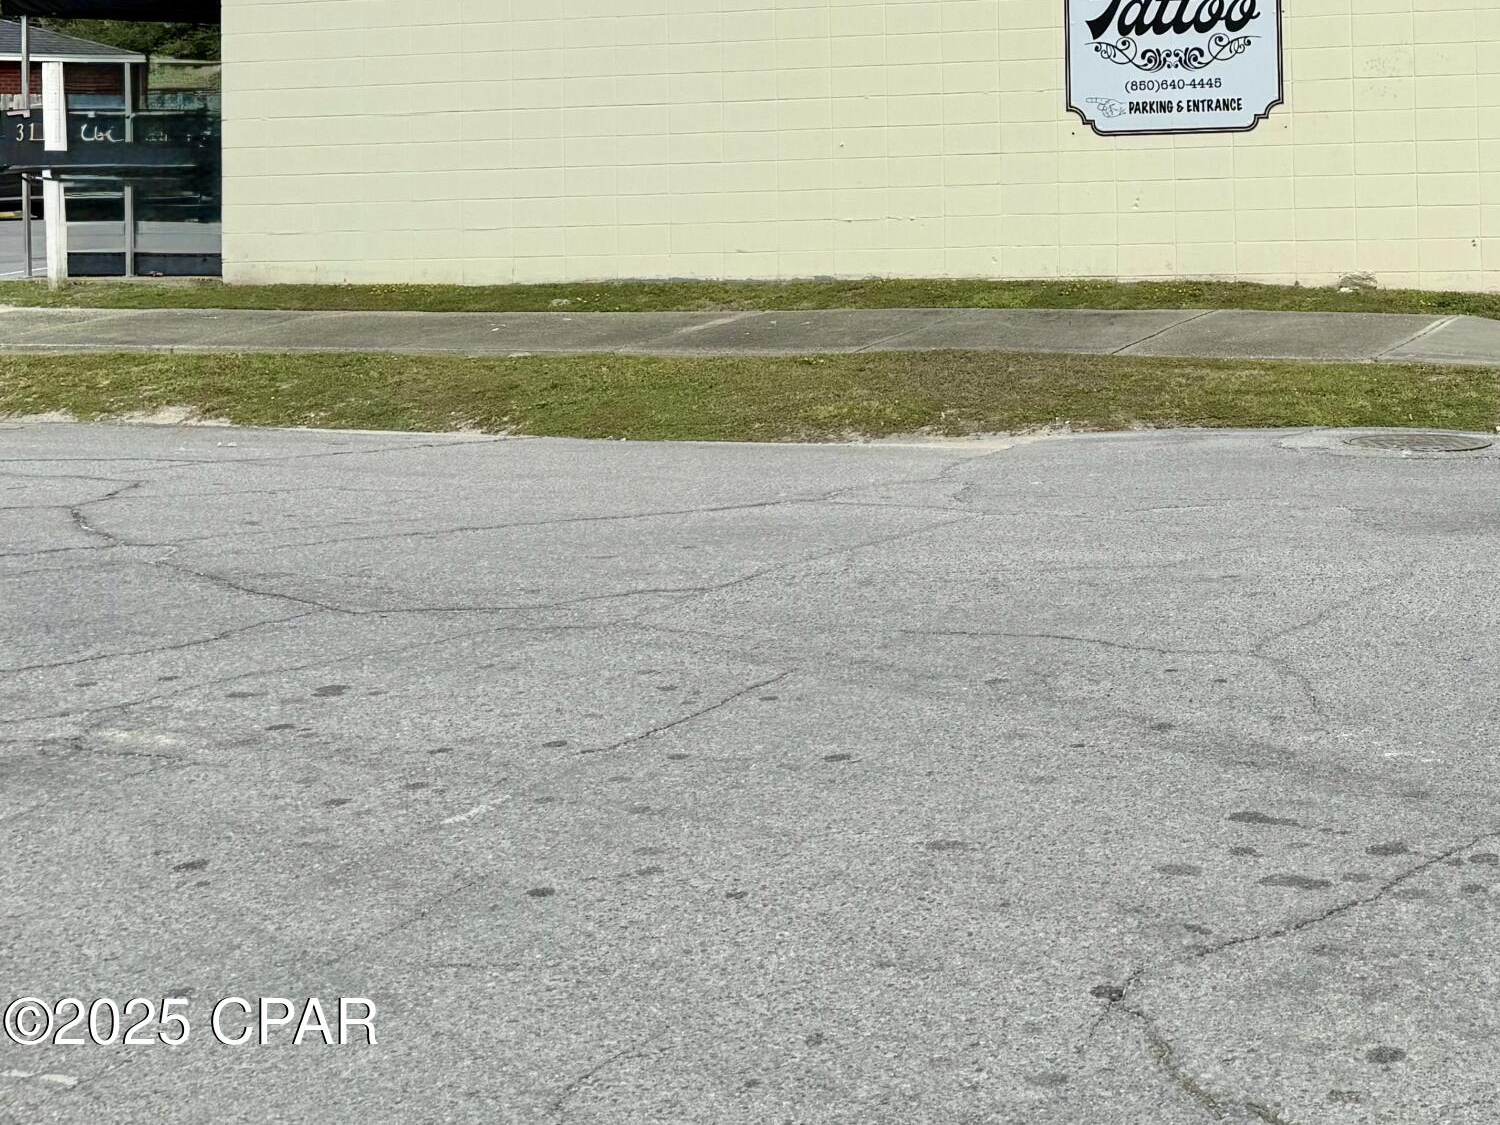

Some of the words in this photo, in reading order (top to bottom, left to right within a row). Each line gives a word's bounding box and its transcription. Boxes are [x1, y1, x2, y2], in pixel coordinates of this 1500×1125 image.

[1125, 77, 1222, 93] (850)640-4445
[1128, 100, 1174, 114] PARKING
[1176, 100, 1183, 113] &
[1186, 98, 1243, 113] ENTRANCE
